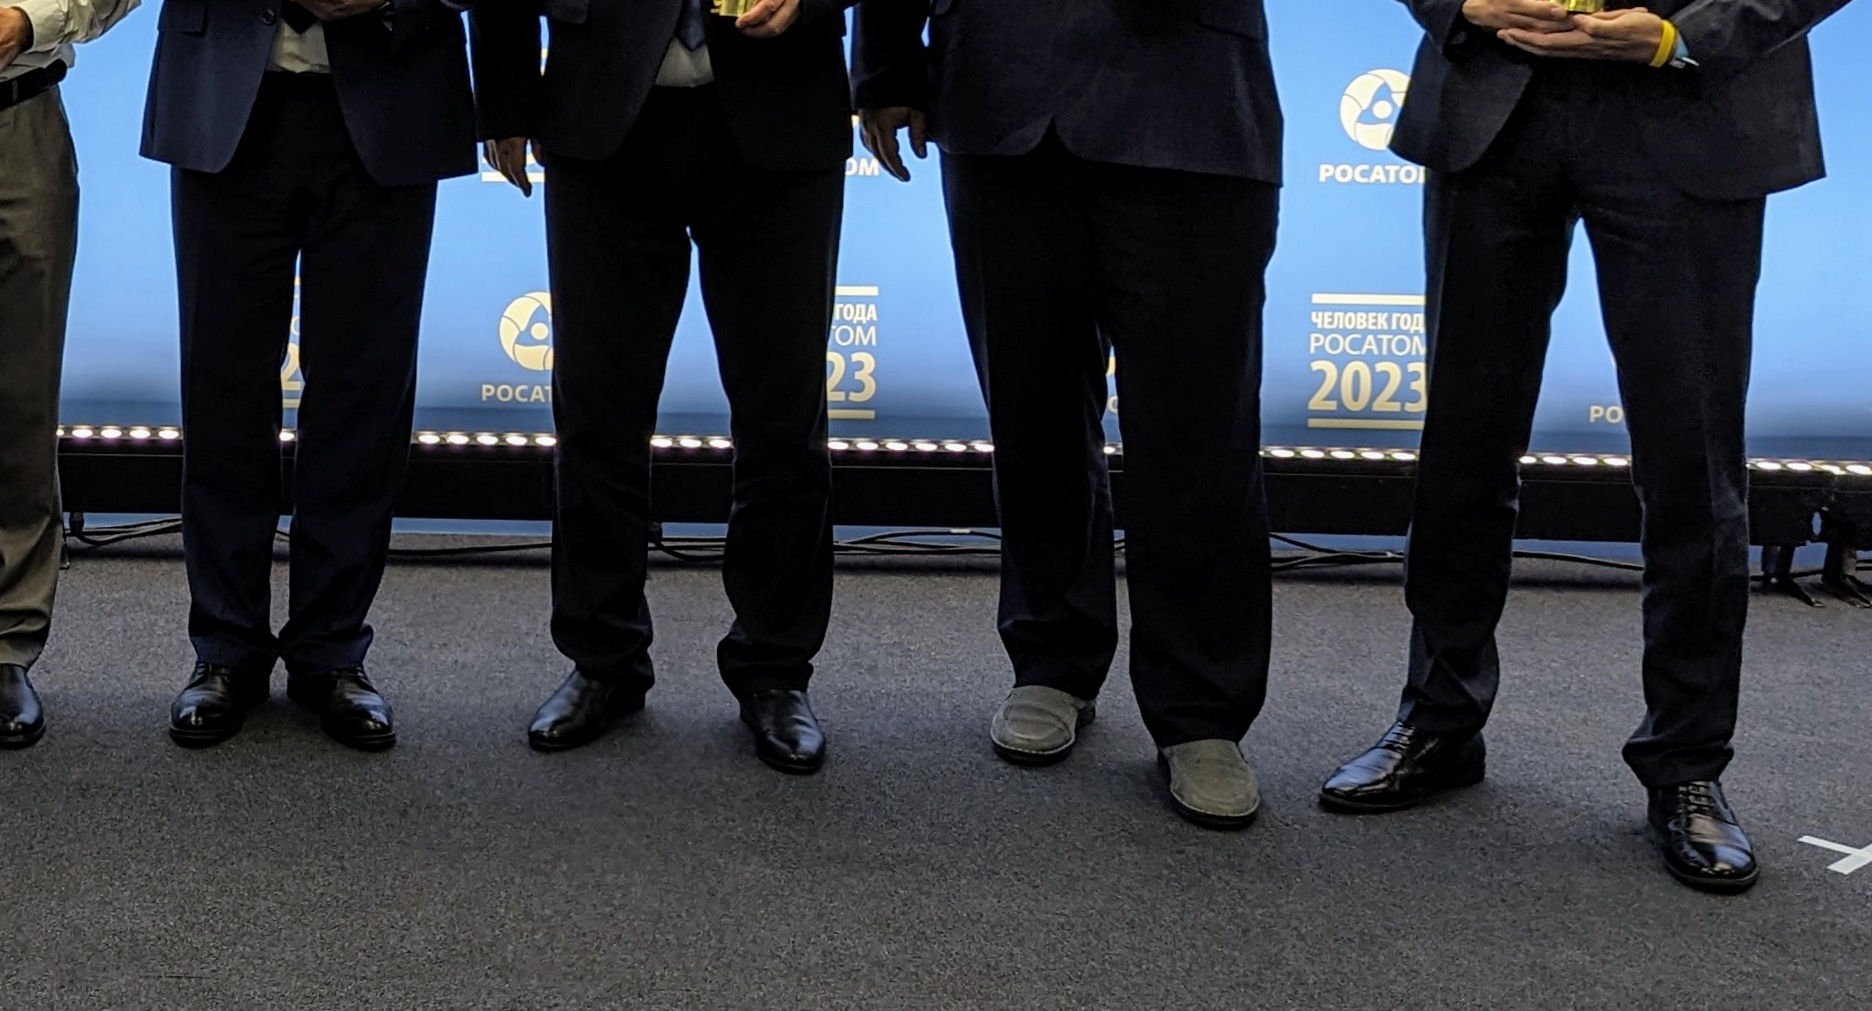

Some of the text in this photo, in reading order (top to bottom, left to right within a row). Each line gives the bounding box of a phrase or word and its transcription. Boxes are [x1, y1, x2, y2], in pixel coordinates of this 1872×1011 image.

[1319, 164, 1427, 186] РОСАТО
[831, 304, 876, 323] ГОДА
[1312, 312, 1426, 332] ЧЕЛОВЕК ГОД
[826, 353, 876, 403] 23
[1309, 361, 1427, 413] 2023
[481, 384, 552, 403] РОСАТ
